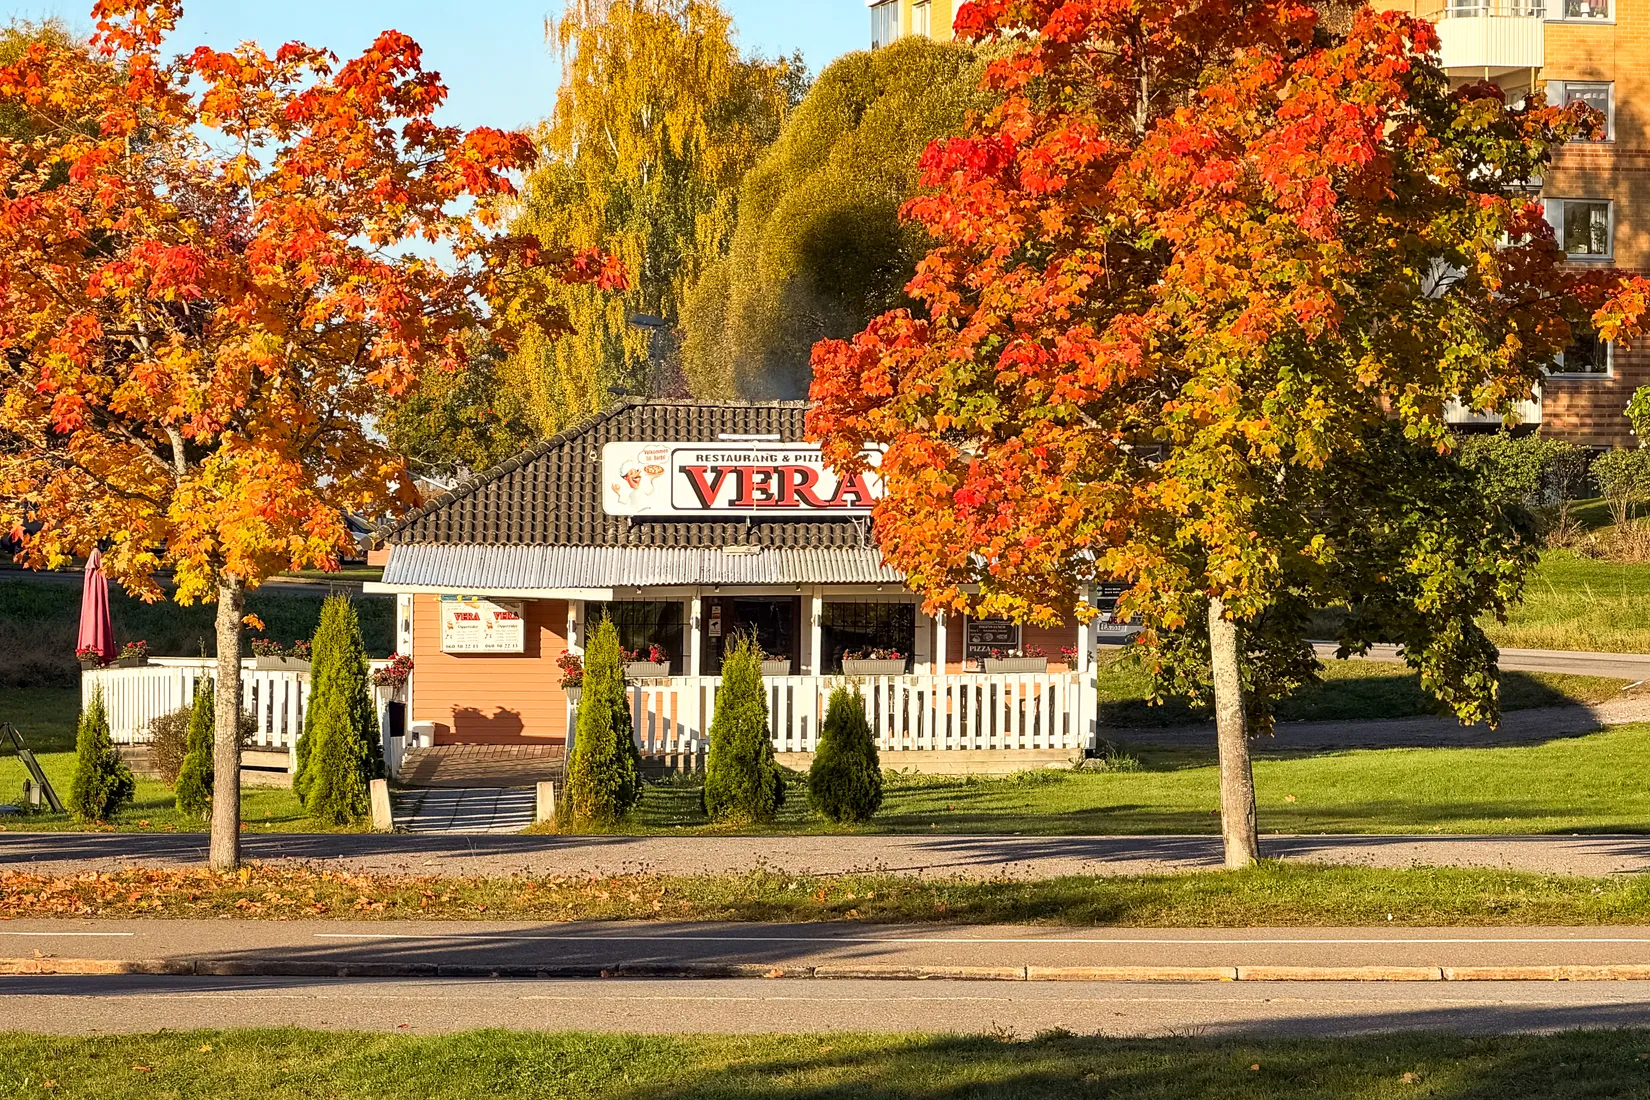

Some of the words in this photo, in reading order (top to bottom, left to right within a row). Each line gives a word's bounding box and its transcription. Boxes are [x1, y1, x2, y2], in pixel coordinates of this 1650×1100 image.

[696, 454, 778, 462] RESTAURANG
[782, 454, 790, 462] &
[679, 465, 876, 509] VERA
[454, 612, 480, 621] VERA
[493, 611, 520, 620] VERA
